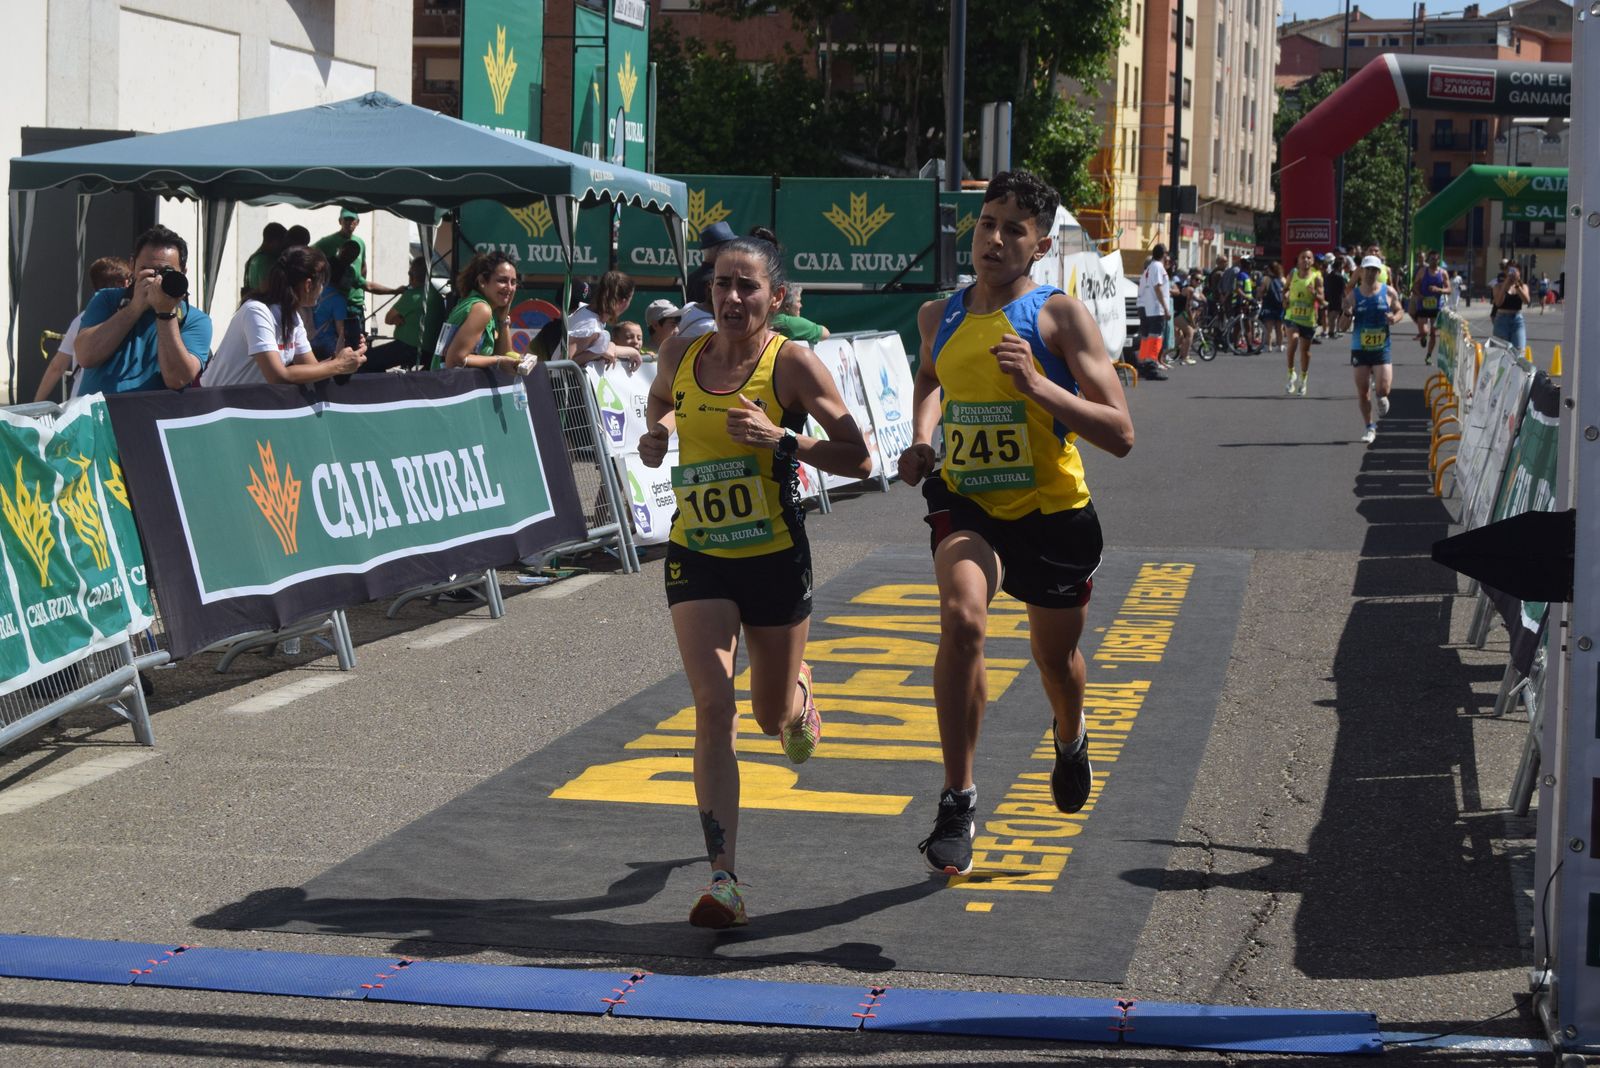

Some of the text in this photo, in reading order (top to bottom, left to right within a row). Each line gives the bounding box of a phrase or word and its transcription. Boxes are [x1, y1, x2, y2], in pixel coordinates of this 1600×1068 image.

[1510, 71, 1566, 87] CON EL
[1443, 84, 1491, 96] ZAMORA
[630, 247, 680, 266] CAJA
[793, 252, 924, 272] CAJA RURAL
[1364, 334, 1381, 345] 211
[960, 405, 1013, 415] FUNDACION
[960, 414, 1014, 424] CAJA RURAL
[951, 429, 1020, 466] 245
[695, 460, 746, 475] FUNDACION
[964, 472, 1030, 486] CAJA RURAL
[311, 444, 506, 539] CAJA RURAL
[684, 483, 753, 524] 160
[730, 527, 767, 541] RURAL
[1116, 562, 1197, 617] INTERIORES
[1092, 618, 1175, 663] DISEÑO
